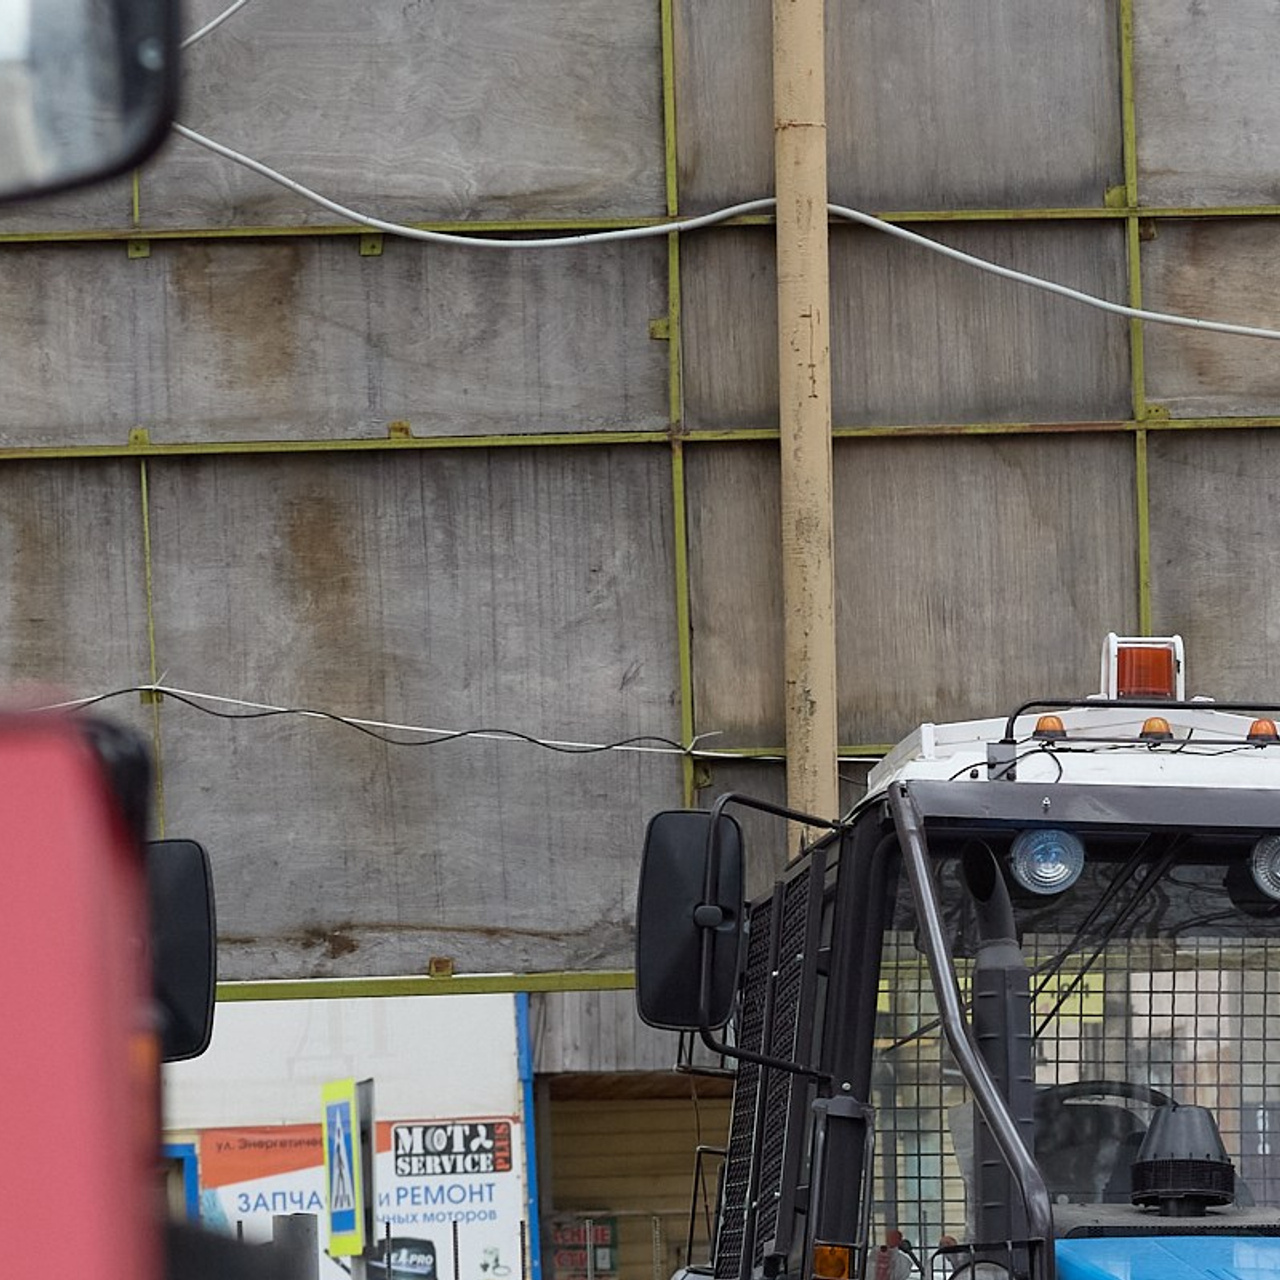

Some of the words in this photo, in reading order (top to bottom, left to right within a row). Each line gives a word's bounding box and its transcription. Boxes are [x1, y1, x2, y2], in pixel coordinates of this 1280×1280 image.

[238, 1136, 324, 1150] Энергетичес
[396, 1153, 494, 1176] SERVICE
[237, 1190, 324, 1213] ЗАПЧА
[396, 1182, 496, 1207] РЕМОНТ
[422, 1209, 498, 1225] моторов
